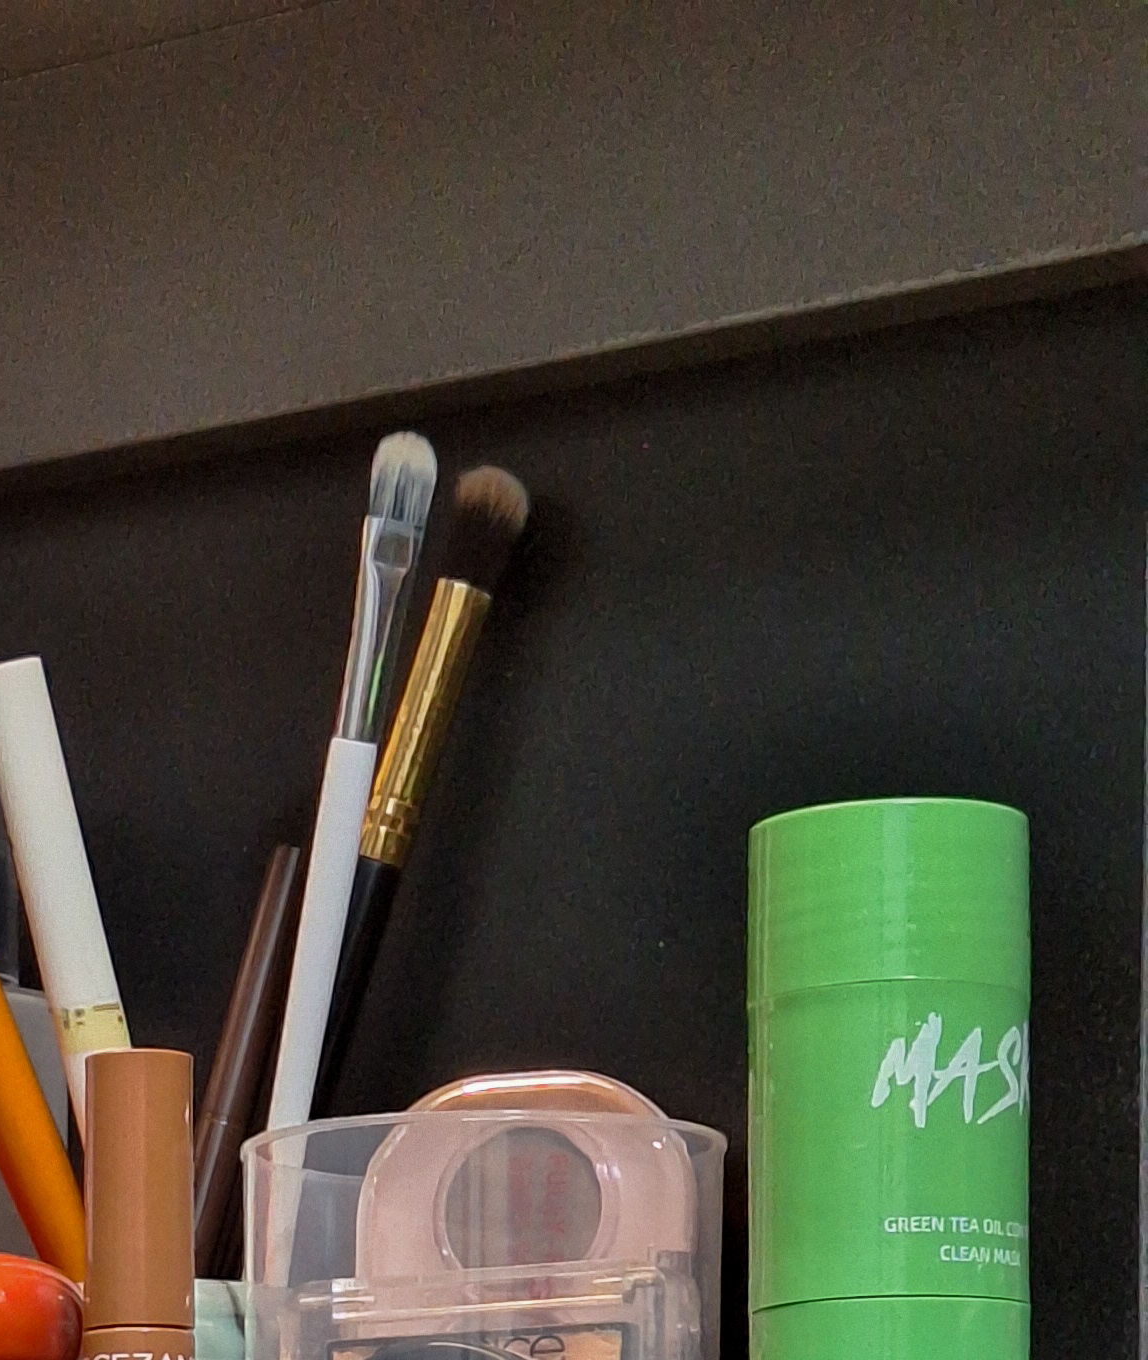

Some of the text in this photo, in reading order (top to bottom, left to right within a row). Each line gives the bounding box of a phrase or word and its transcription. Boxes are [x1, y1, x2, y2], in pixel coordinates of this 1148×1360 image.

[884, 1216, 945, 1233] GREEN
[949, 1216, 980, 1232] TEA
[983, 1218, 1005, 1236] OIL
[940, 1245, 991, 1263] CLEAN
